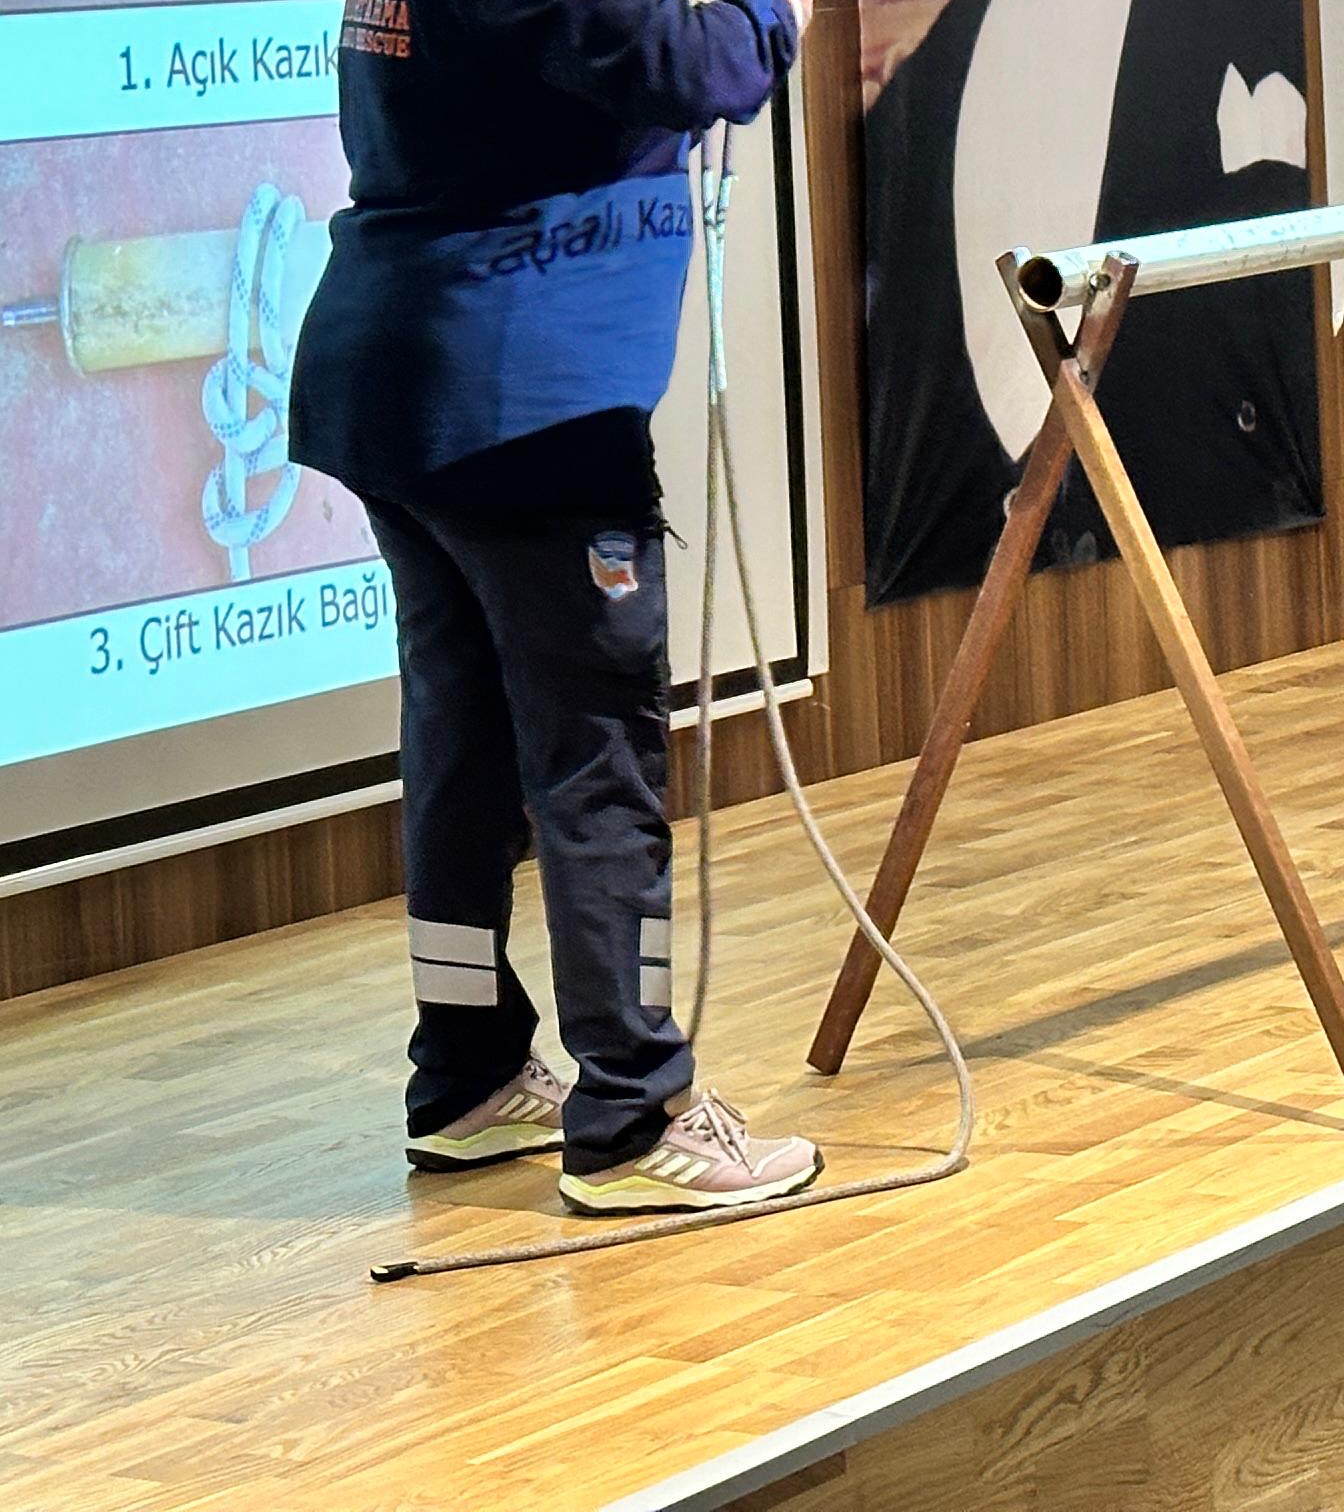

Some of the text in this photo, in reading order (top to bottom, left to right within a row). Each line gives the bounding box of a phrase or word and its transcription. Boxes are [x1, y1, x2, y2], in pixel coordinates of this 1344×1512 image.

[119, 29, 341, 98] 1. Açık Kazık
[89, 570, 388, 676] 3. Çift Kazık Bağı
